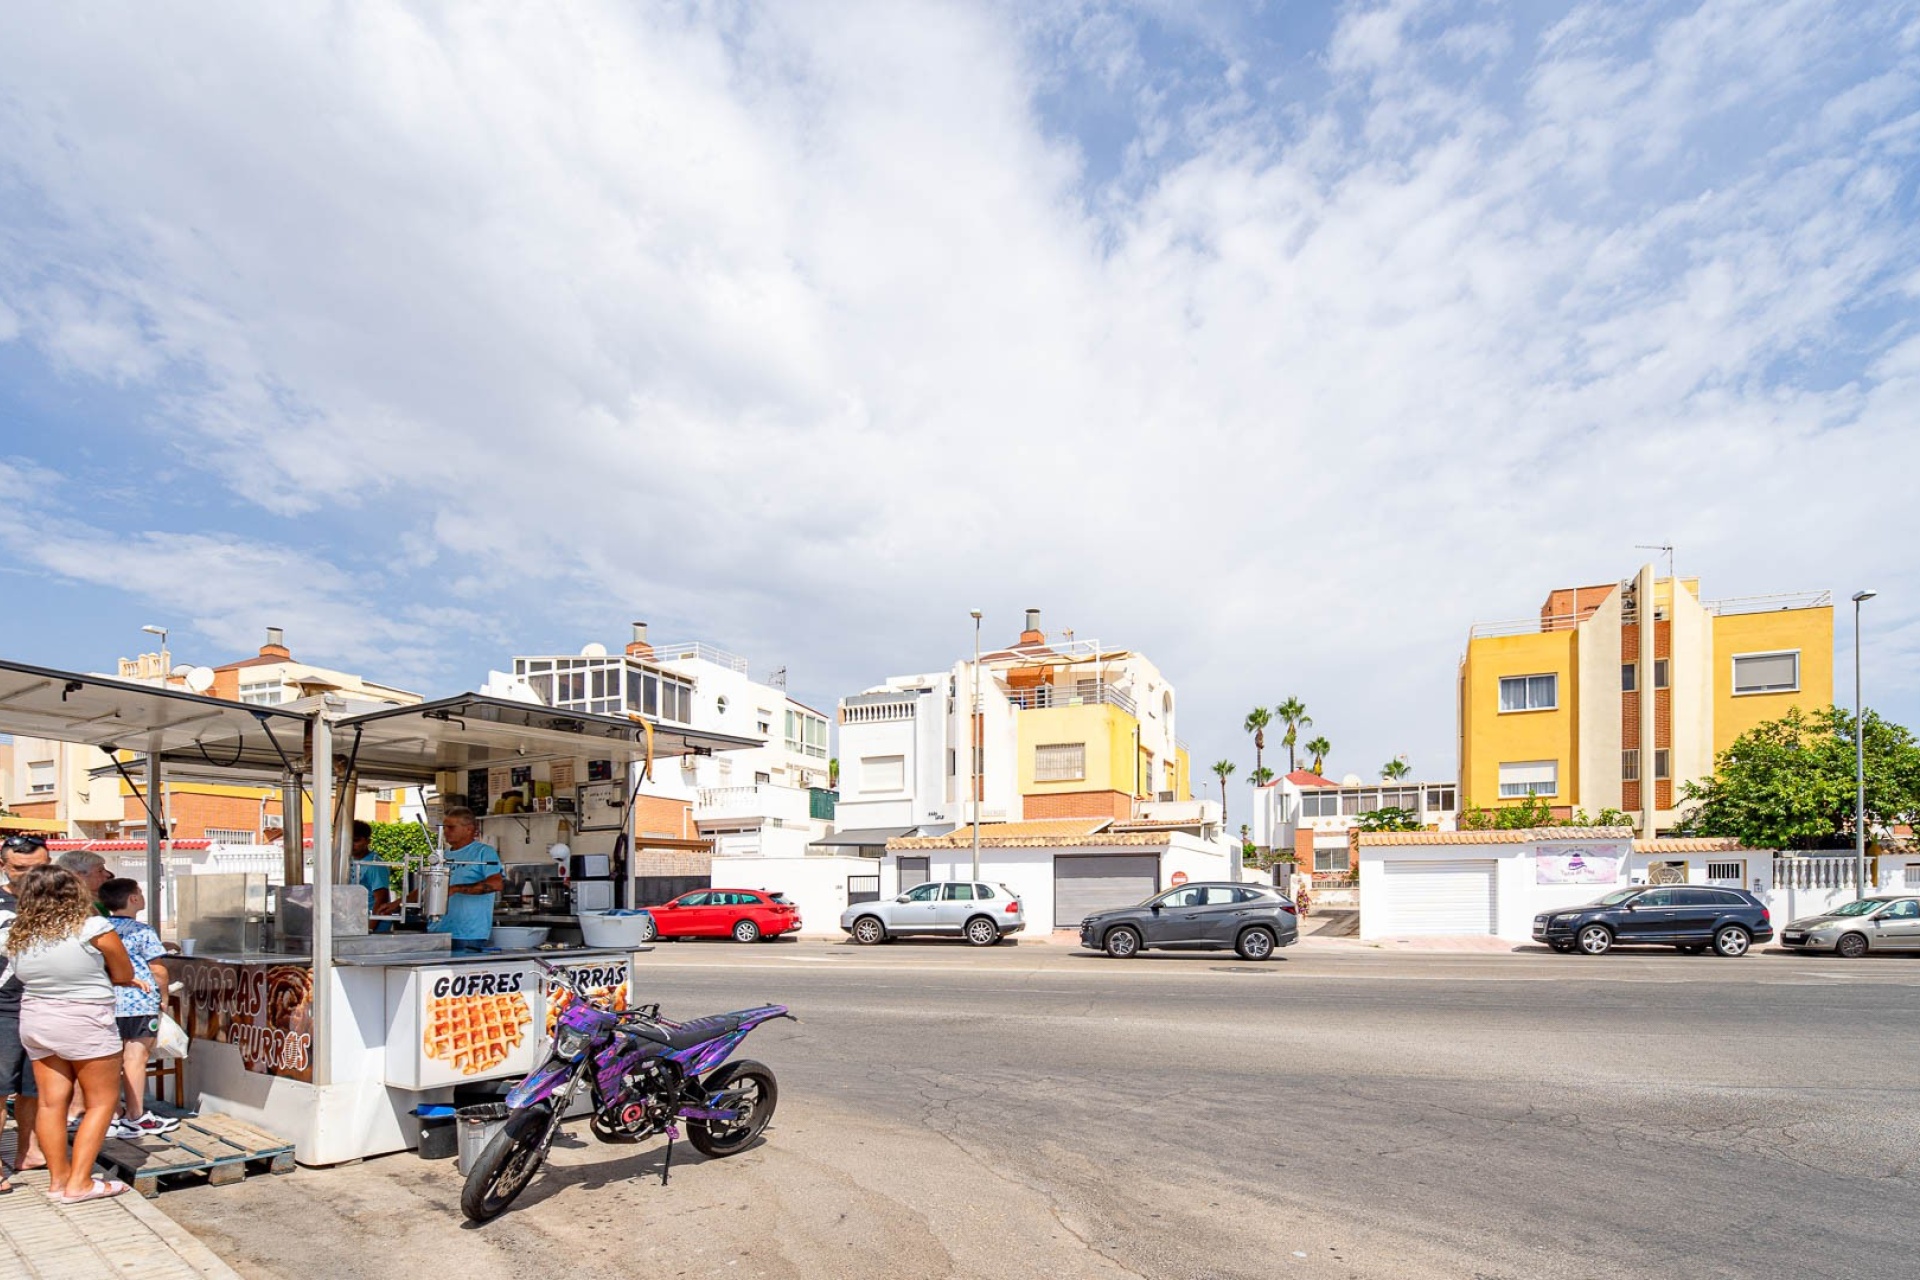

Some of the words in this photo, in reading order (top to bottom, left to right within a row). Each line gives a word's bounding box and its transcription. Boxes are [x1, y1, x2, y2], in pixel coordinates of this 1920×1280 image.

[181, 964, 265, 1017] PORRAS
[433, 972, 523, 998] GOFRES
[551, 966, 627, 990] RRAS
